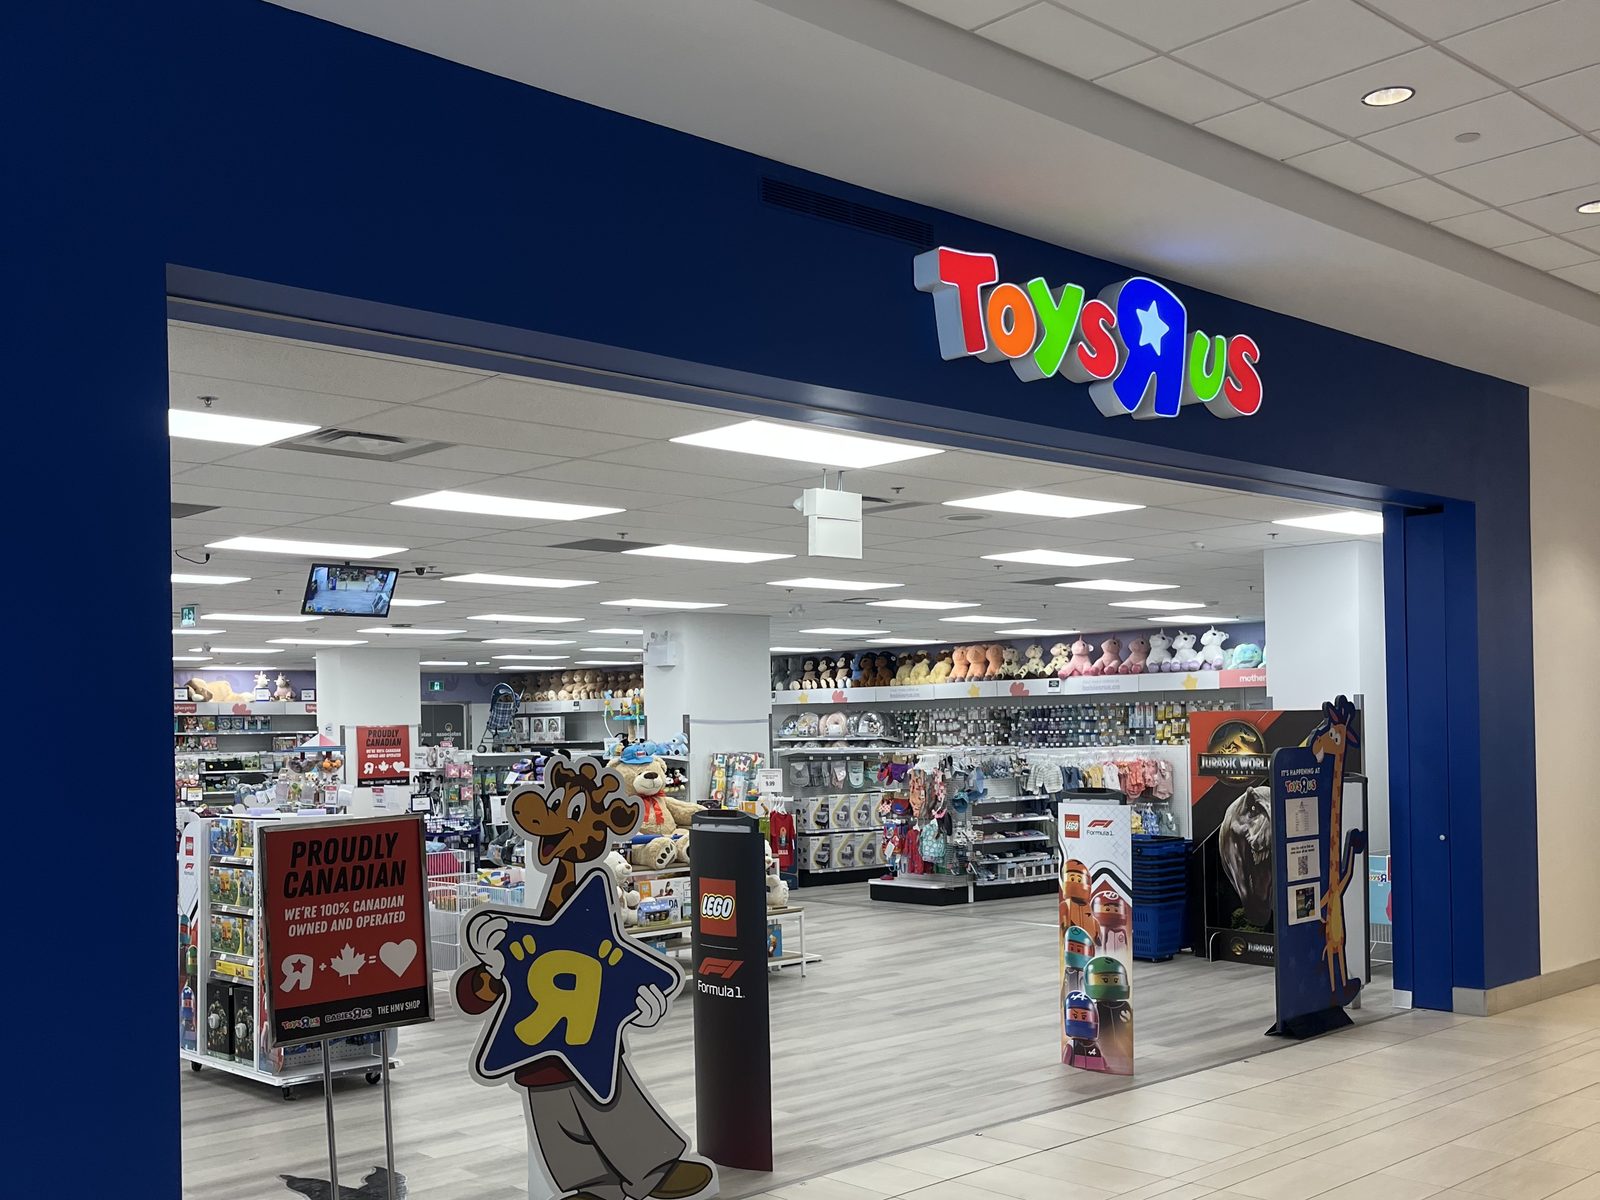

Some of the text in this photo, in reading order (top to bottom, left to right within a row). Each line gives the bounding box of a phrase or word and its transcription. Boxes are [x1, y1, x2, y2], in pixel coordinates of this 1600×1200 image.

[368, 729, 399, 737] PROUDLY
[366, 738, 402, 747] CANADIAN
[1200, 755, 1271, 769] JURASSIC WORL
[1290, 768, 1314, 776] HAPPENING
[290, 832, 399, 868] PROUDLY
[283, 860, 407, 899] CANADIAN
[284, 895, 405, 921] WE'RE 100% CANADIAN
[701, 892, 734, 920] LEGO
[288, 911, 406, 937] OWNED AND OPERATED
[1247, 943, 1274, 954] JURASSIC
[377, 1006, 389, 1015] THE
[390, 1003, 404, 1014] HMV
[405, 1000, 421, 1011] SHOP
